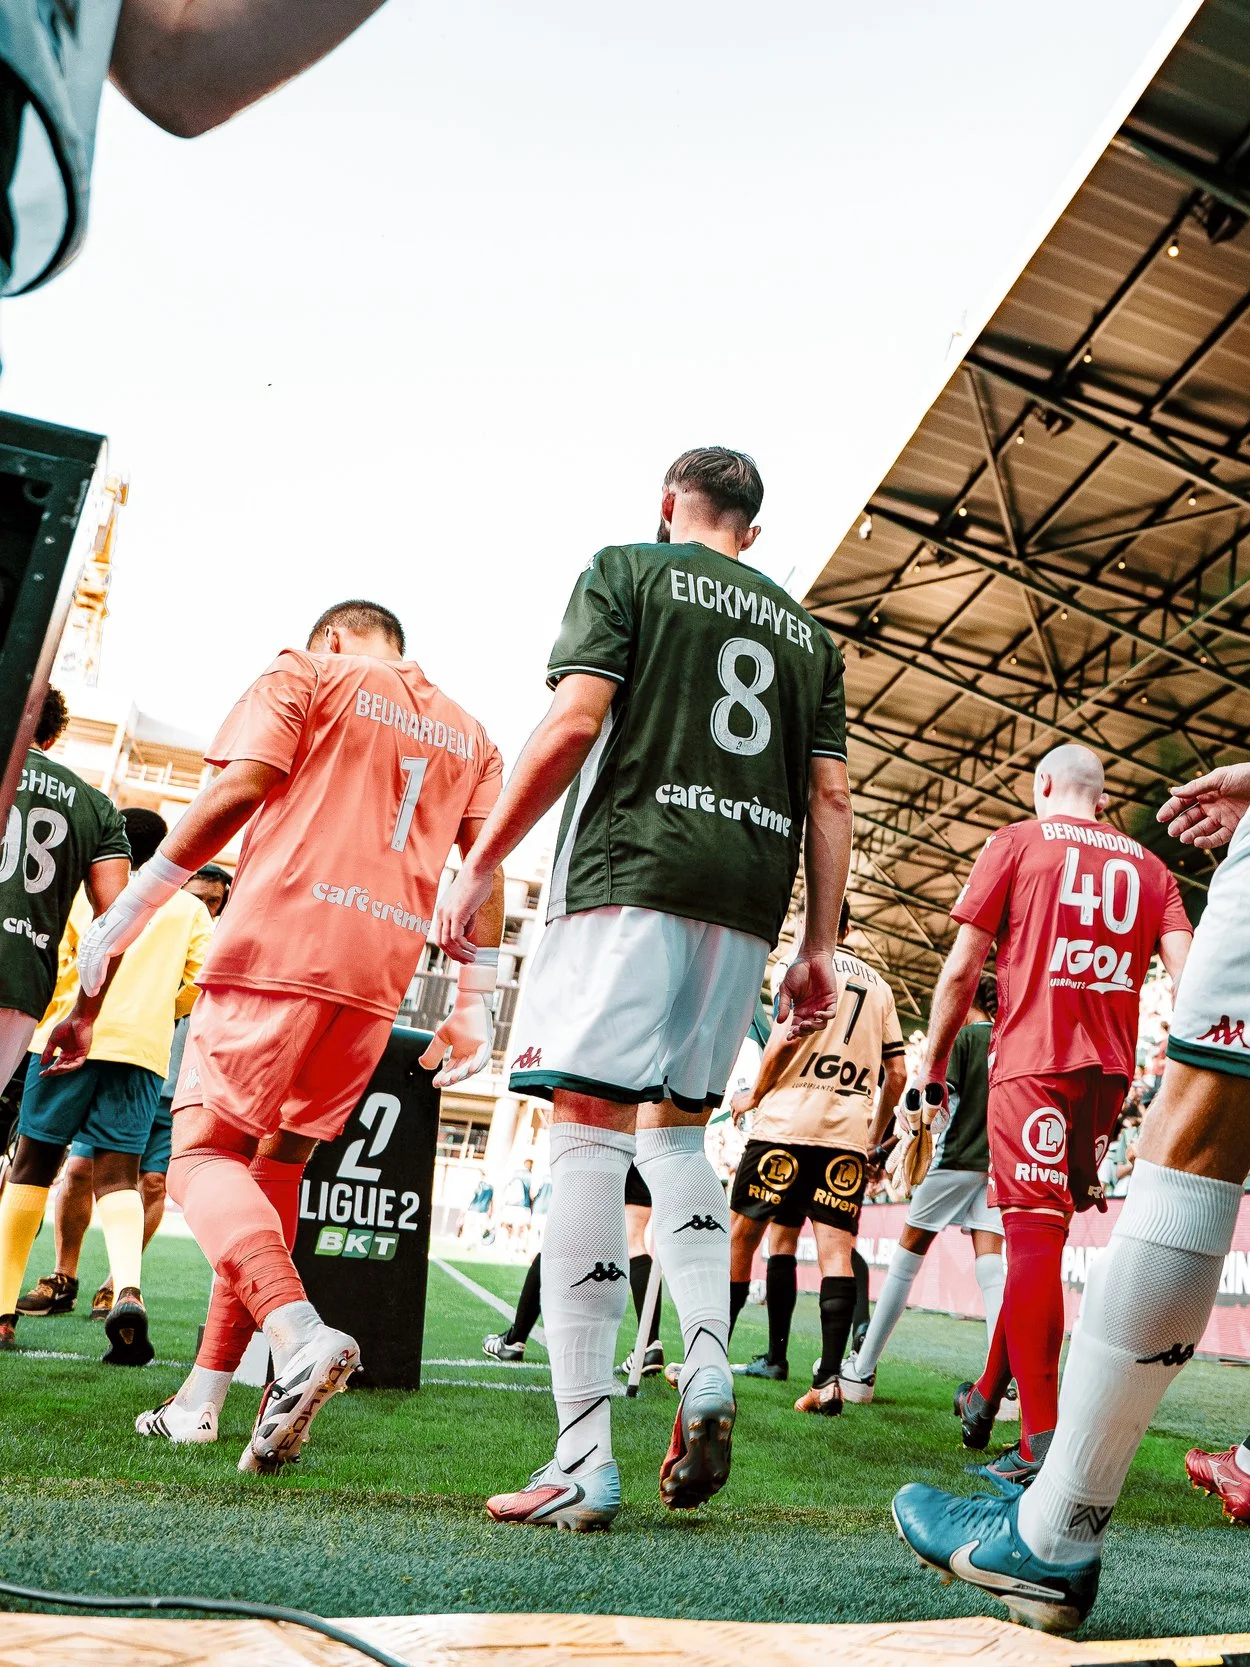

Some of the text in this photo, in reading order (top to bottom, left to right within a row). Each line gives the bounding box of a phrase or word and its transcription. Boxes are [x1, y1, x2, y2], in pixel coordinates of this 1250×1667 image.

[670, 568, 814, 654] EICKMAYER
[710, 637, 775, 756] 8
[16, 769, 76, 808] CHEM
[391, 756, 429, 853] 1
[655, 784, 792, 838] café crème
[1041, 823, 1144, 860] BERNARDONI
[312, 882, 432, 936] café crème
[1059, 846, 1140, 934] 40
[833, 958, 878, 985] EAUTEY
[844, 981, 867, 1046] 7
[336, 1092, 401, 1182] 2
[299, 1179, 420, 1231] LIGUE 2
[748, 1184, 782, 1205] Rive
[316, 1229, 398, 1258] BKT
